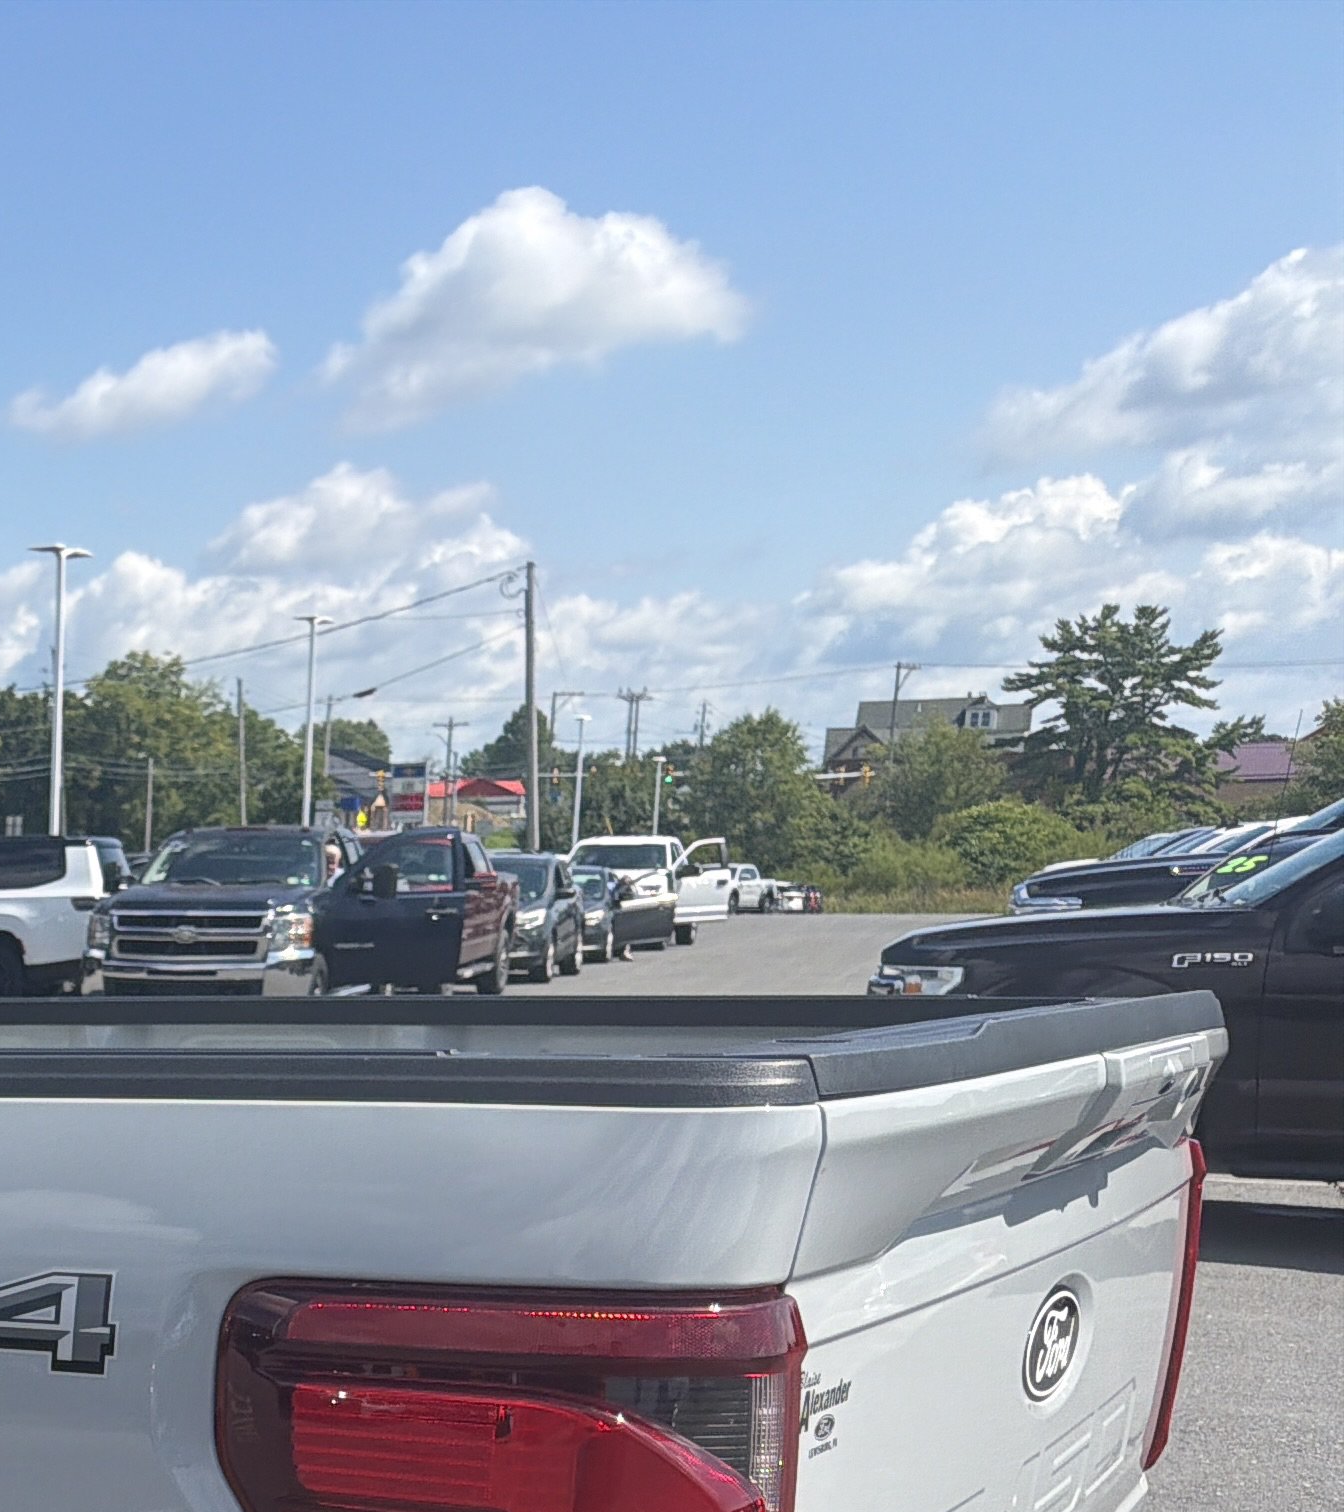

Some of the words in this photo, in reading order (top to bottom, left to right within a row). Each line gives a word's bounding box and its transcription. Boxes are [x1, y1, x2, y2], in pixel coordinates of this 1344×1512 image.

[1216, 855, 1268, 873] 25
[1033, 1304, 1077, 1385] Ford
[799, 1378, 851, 1434] Alexander
